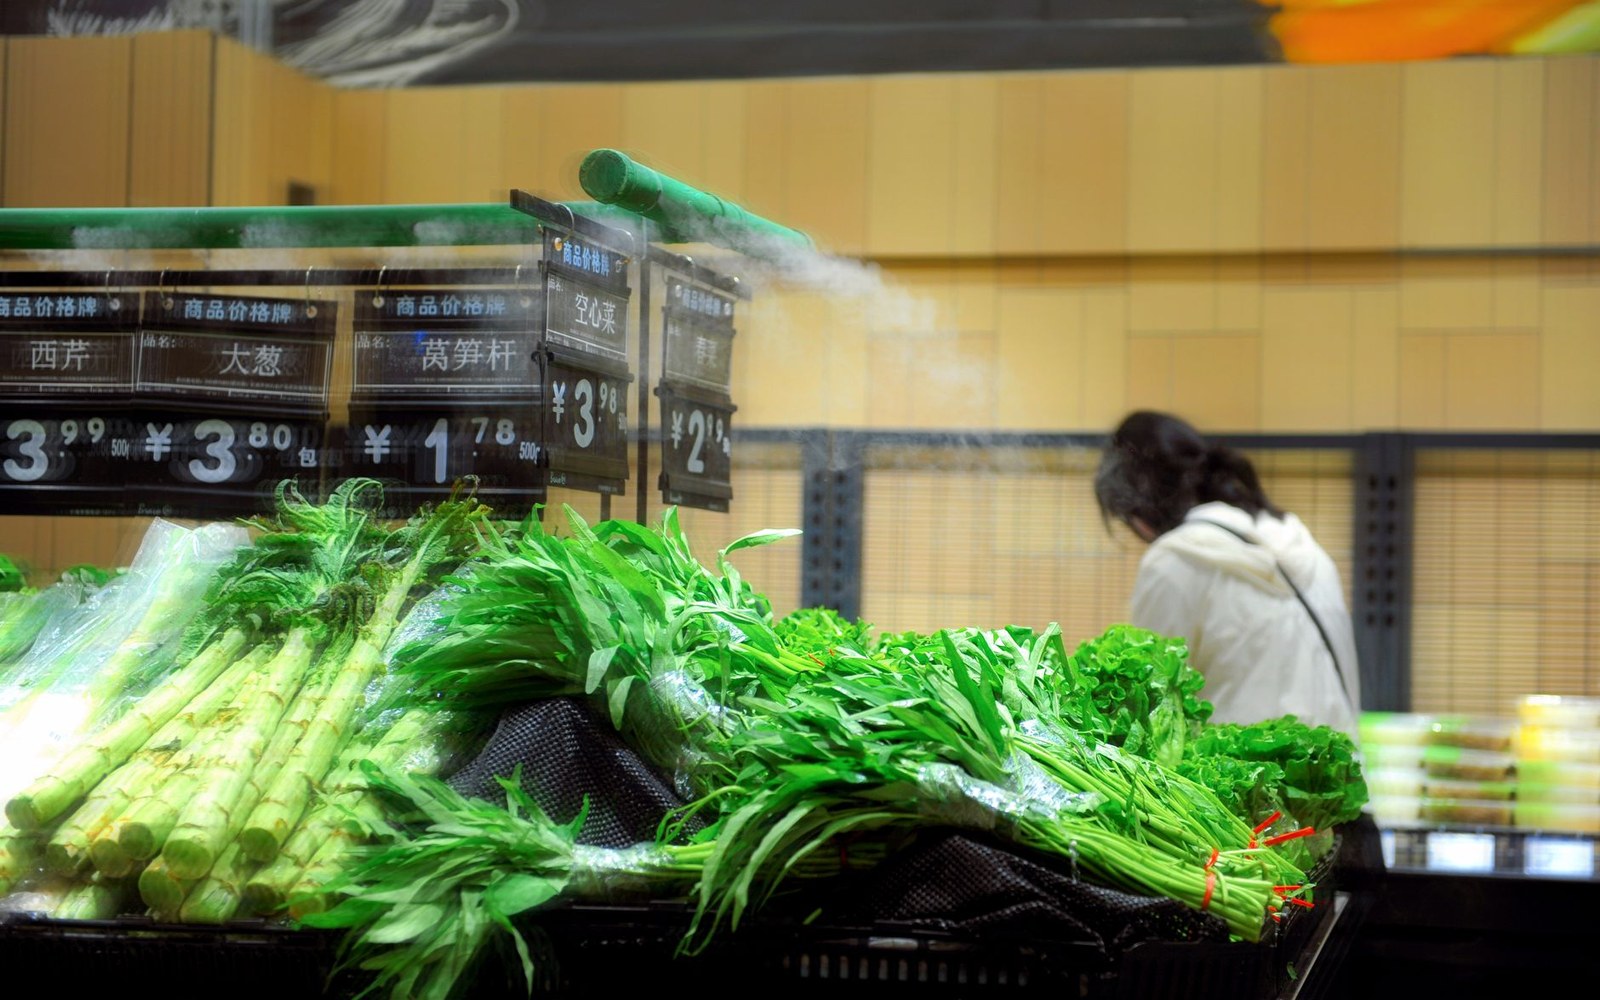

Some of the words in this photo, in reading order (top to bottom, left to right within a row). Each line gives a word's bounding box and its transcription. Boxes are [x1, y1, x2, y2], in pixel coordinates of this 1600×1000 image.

[563, 241, 610, 277] 商品价格牌
[184, 299, 292, 323] 商品价格牌
[396, 295, 506, 317] 商品价格牌
[575, 292, 616, 335] 空心菜
[30, 338, 91, 371] 西芹
[219, 343, 283, 377] 大葱
[421, 338, 517, 371] 莴笋杆
[3, 417, 105, 482] 3.99
[188, 419, 292, 483] 3.80
[298, 447, 317, 467] 包
[424, 417, 516, 484] 1.78
